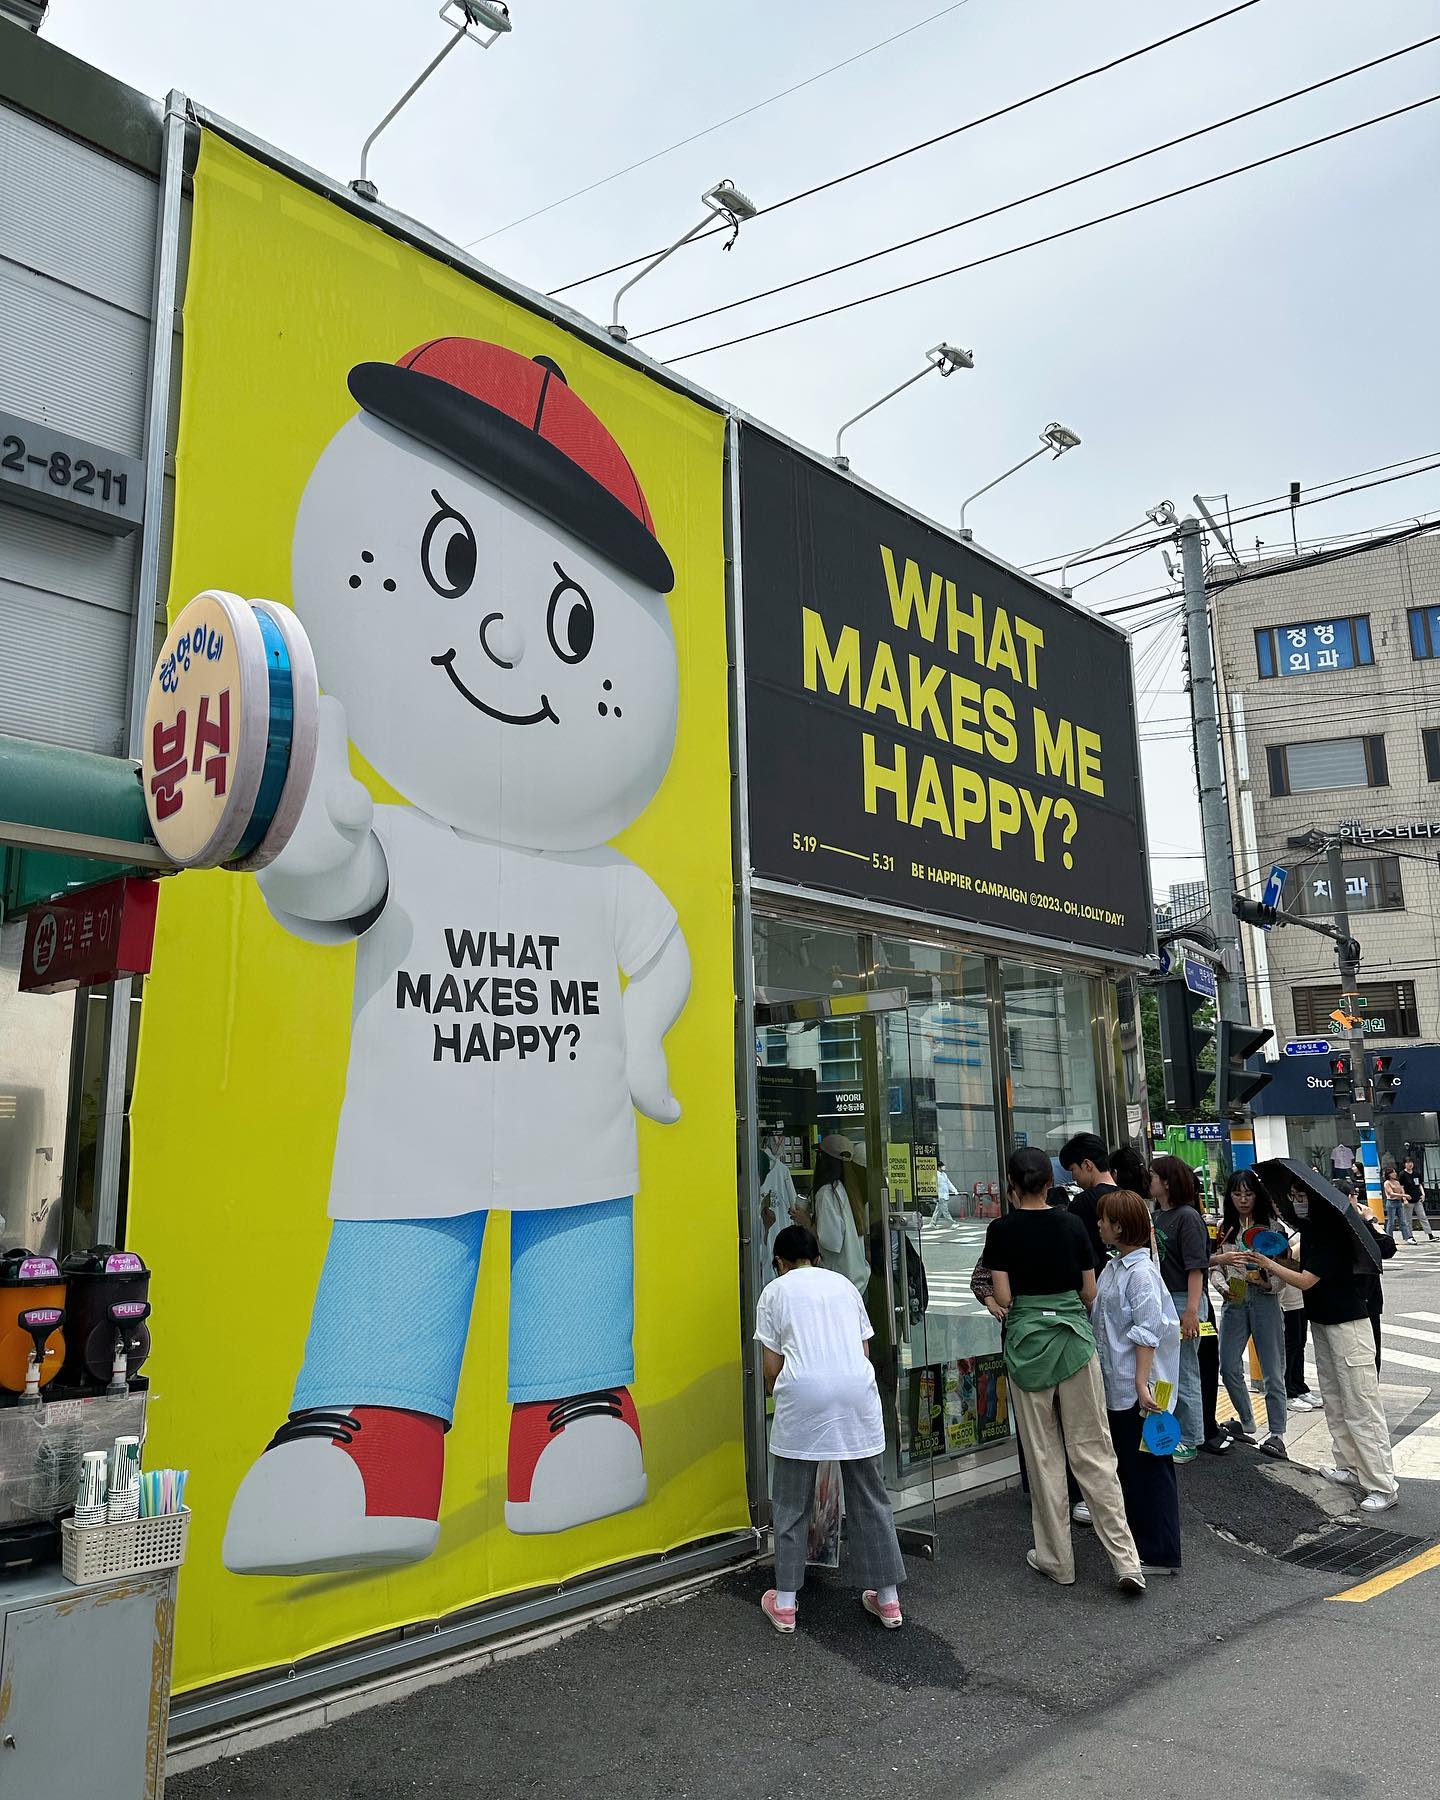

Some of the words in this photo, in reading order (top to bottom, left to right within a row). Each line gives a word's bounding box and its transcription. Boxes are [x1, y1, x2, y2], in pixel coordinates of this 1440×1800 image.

[1, 435, 128, 505] 2-8211
[879, 543, 1045, 691] WHAT
[1286, 624, 1335, 648] 정형
[1289, 649, 1340, 671] 외과
[802, 605, 1018, 764] MAKES
[1033, 706, 1105, 798] ME
[150, 689, 230, 821] 분식
[861, 731, 1079, 870] HAPPY?
[792, 832, 818, 853] 5.19
[872, 852, 894, 872] 5.31
[911, 862, 925, 880] BE
[927, 867, 972, 891] HAPPIER
[975, 879, 1028, 905] CAMPAIGN
[1105, 910, 1125, 927] DAY!
[443, 927, 560, 971] WHAT
[396, 970, 539, 1017] MAKES
[550, 979, 600, 1016] ME
[432, 1021, 581, 1063] HAPPY?
[835, 1093, 861, 1102] WOORI
[34, 1268, 56, 1276] Slush
[31, 1312, 57, 1321] PULL
[117, 1304, 141, 1314] PULL
